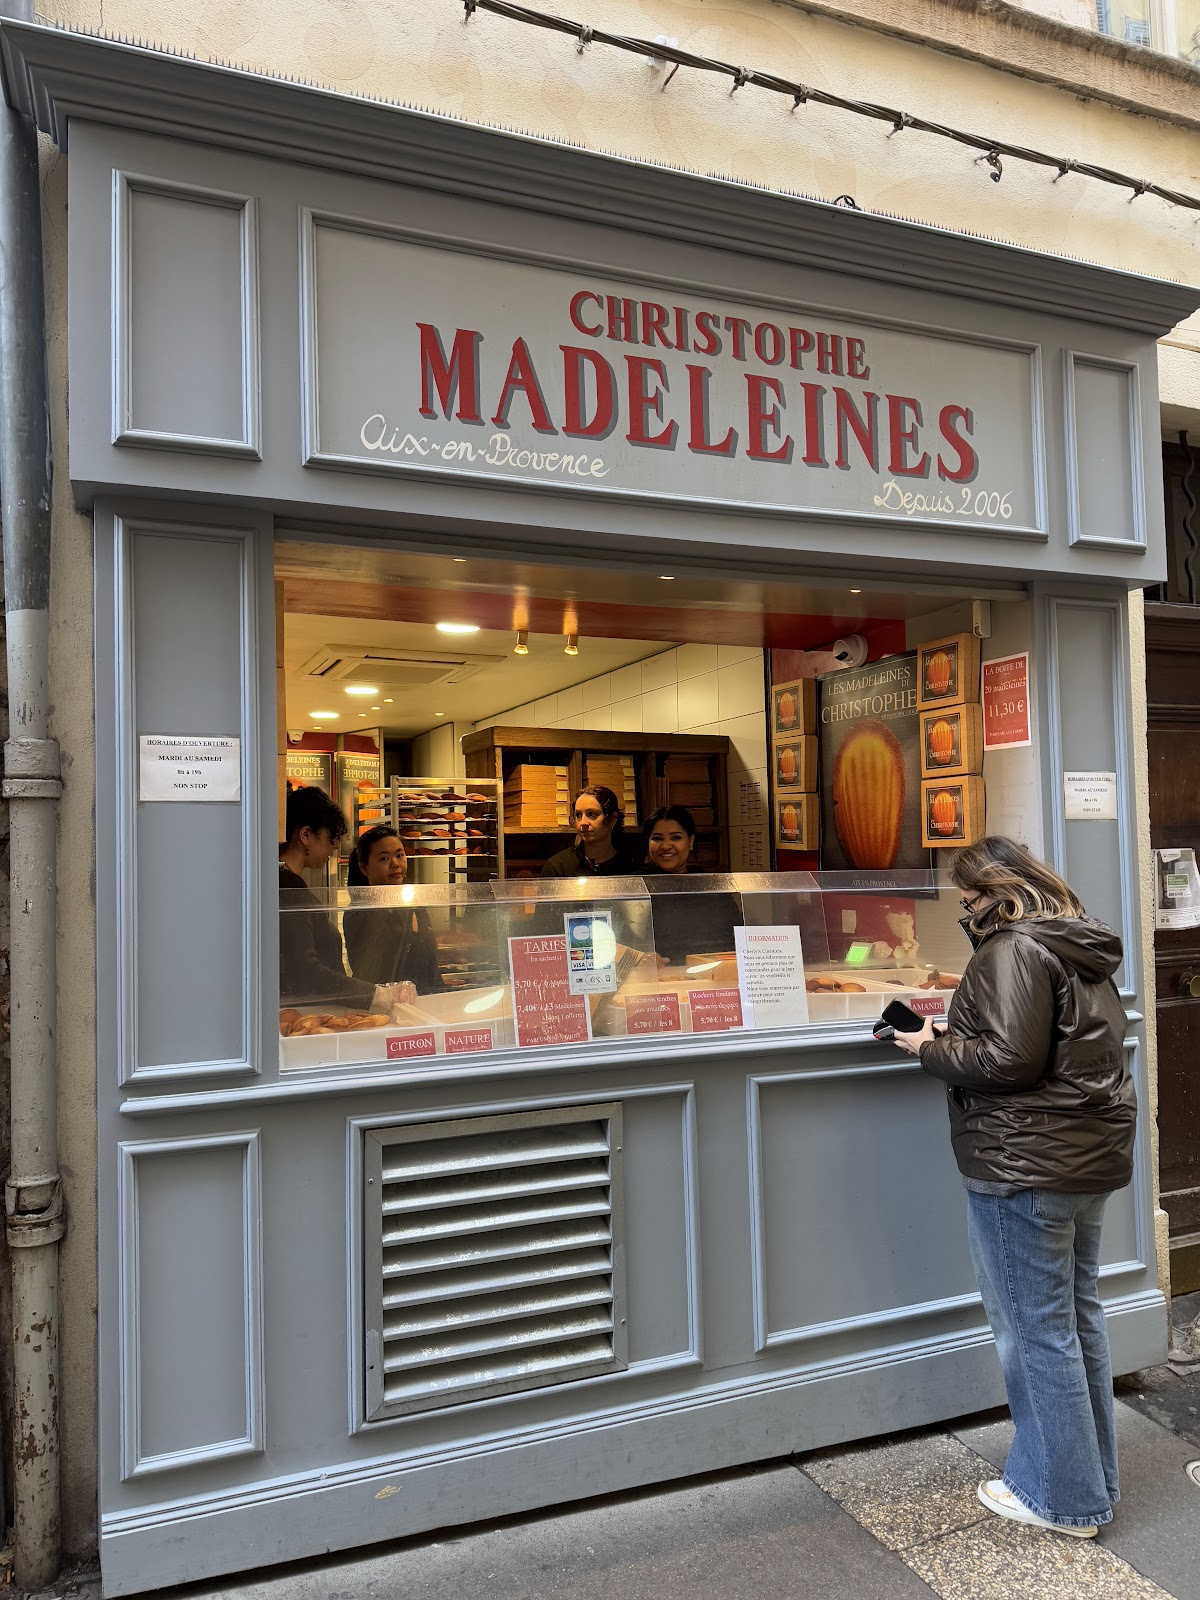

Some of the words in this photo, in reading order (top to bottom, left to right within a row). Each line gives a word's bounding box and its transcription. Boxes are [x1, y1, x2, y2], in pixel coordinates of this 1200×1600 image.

[569, 290, 871, 381] CHRISTOPHE
[415, 322, 980, 484] MADELEINES
[873, 477, 955, 517] Depuis
[956, 487, 1014, 519] 2006
[985, 668, 994, 676] LA
[995, 663, 1015, 674] BOITE
[1015, 660, 1025, 669] DE
[828, 681, 844, 696] LES
[846, 666, 911, 692] MADELEINES
[901, 679, 911, 688] DE
[984, 685, 993, 694] 20
[821, 688, 917, 724] CHRISTOPHE
[989, 701, 1015, 718] 11,30
[1017, 699, 1025, 713] €
[146, 739, 182, 747] HORAIRES
[286, 767, 325, 777] TOPHE
[523, 940, 566, 953] TARIFS
[514, 979, 531, 989] 3,70
[692, 992, 715, 1000] Rochers
[715, 990, 739, 998] fondants
[912, 1001, 944, 1011] AMANDE
[700, 1017, 713, 1025] 5,70
[390, 1037, 433, 1052] CITRON
[448, 1033, 491, 1046] NATURE
